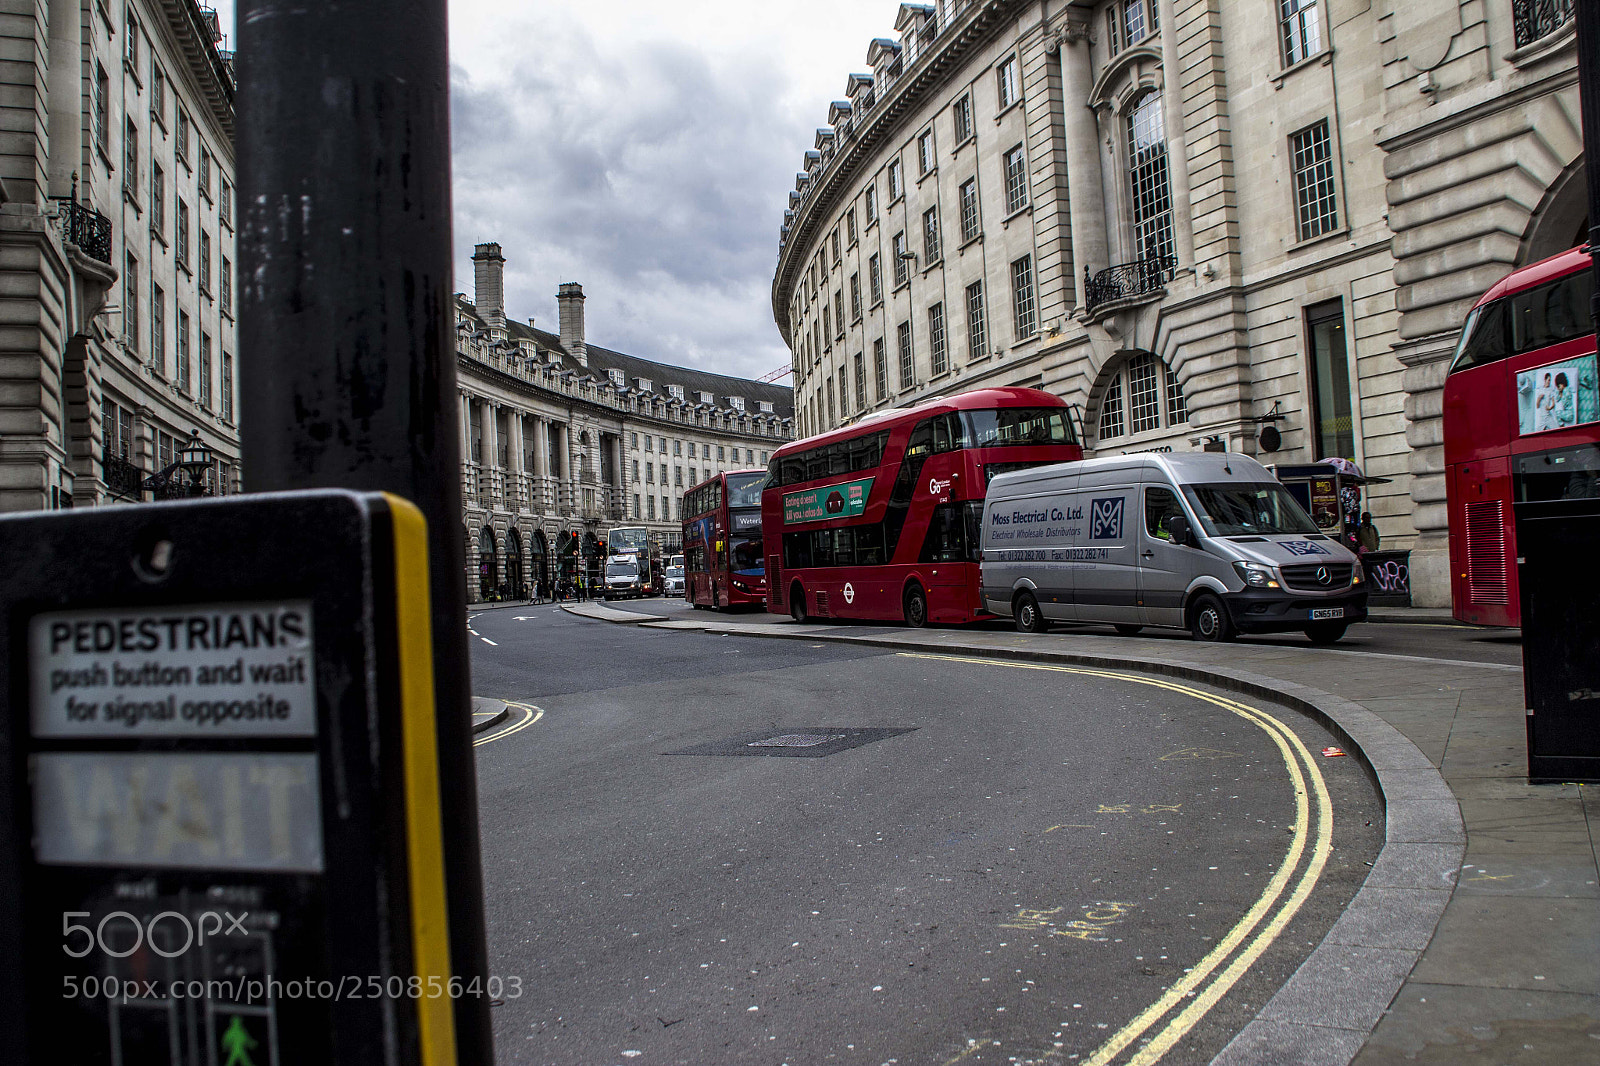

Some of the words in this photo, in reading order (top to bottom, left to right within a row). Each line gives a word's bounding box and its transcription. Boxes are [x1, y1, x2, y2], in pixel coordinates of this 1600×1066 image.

[992, 514, 1010, 526] Moss
[1012, 509, 1048, 524] Electrical
[1051, 508, 1065, 521] Co.
[1067, 506, 1084, 520] Ltd.
[992, 530, 1015, 540] Electrical
[1017, 528, 1044, 539] Wholesale
[1046, 527, 1081, 538] Distributors
[51, 611, 304, 653] PEDESTRIANS
[52, 662, 107, 692] push
[112, 660, 191, 687] button
[196, 658, 242, 685] and
[248, 656, 305, 684] wait
[66, 696, 97, 721] for
[104, 694, 176, 728] signal
[181, 693, 290, 726] opposite
